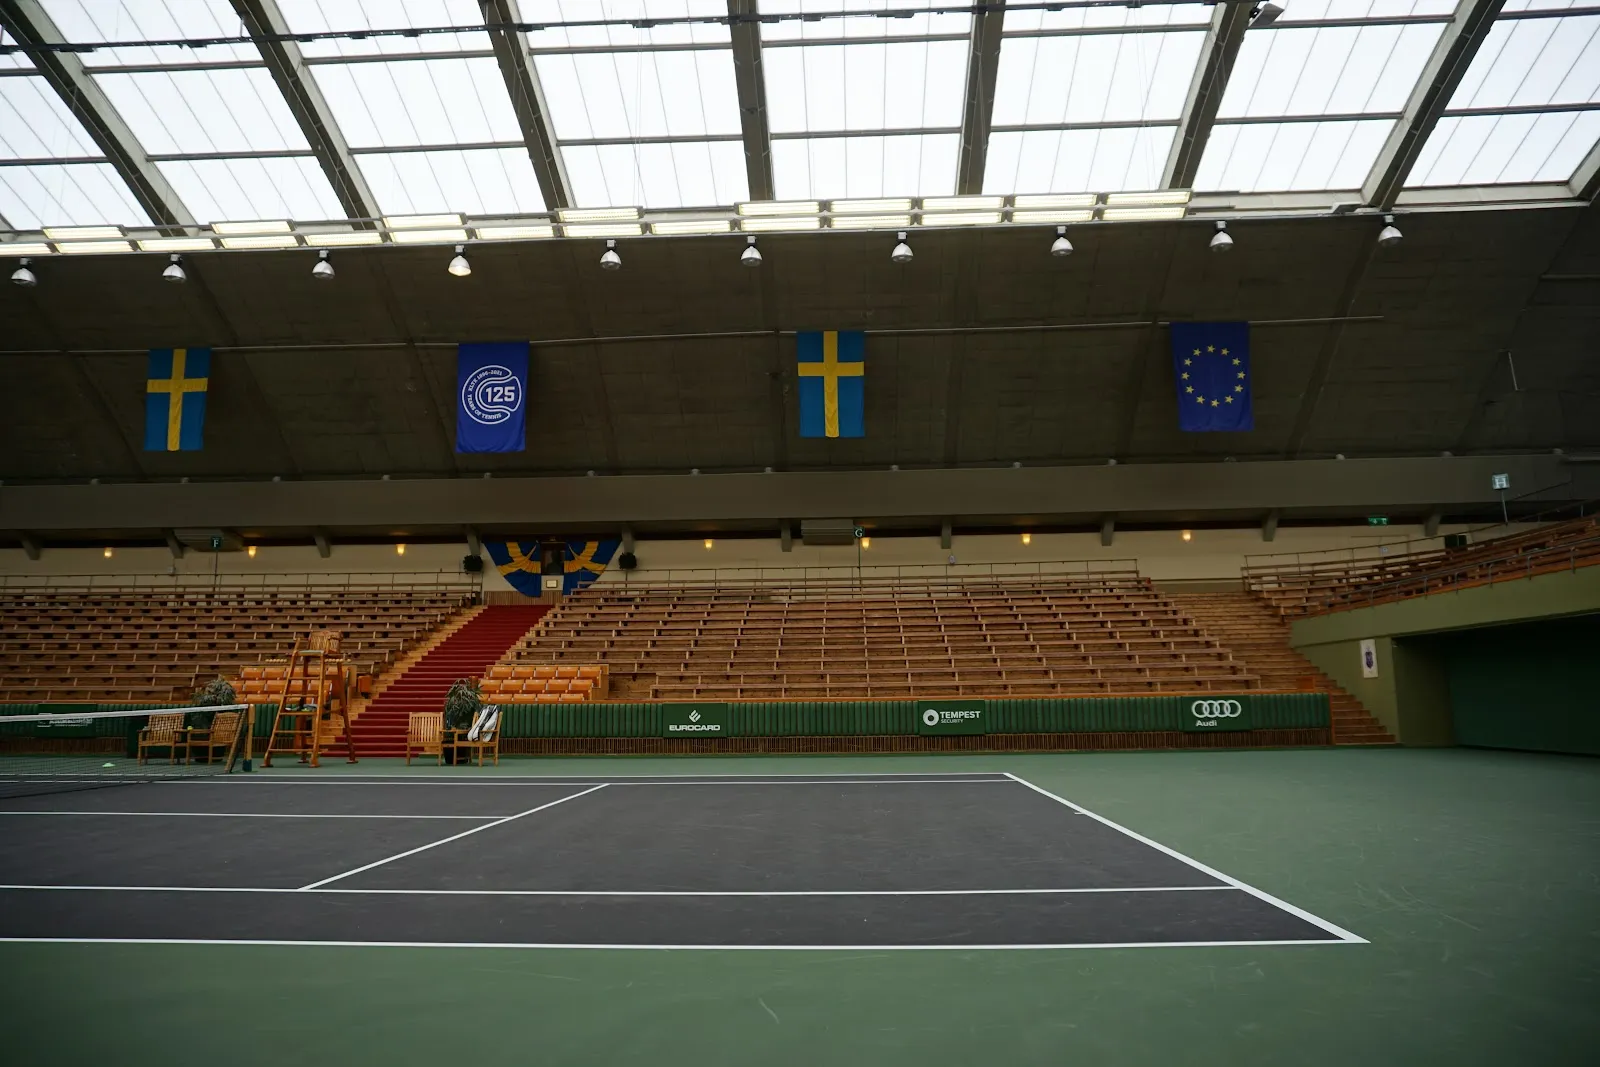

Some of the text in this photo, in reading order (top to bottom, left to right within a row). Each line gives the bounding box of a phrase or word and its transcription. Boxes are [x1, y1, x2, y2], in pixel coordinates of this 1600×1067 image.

[486, 386, 515, 402] 125
[855, 528, 863, 538] G
[939, 711, 981, 719] TEMPEST
